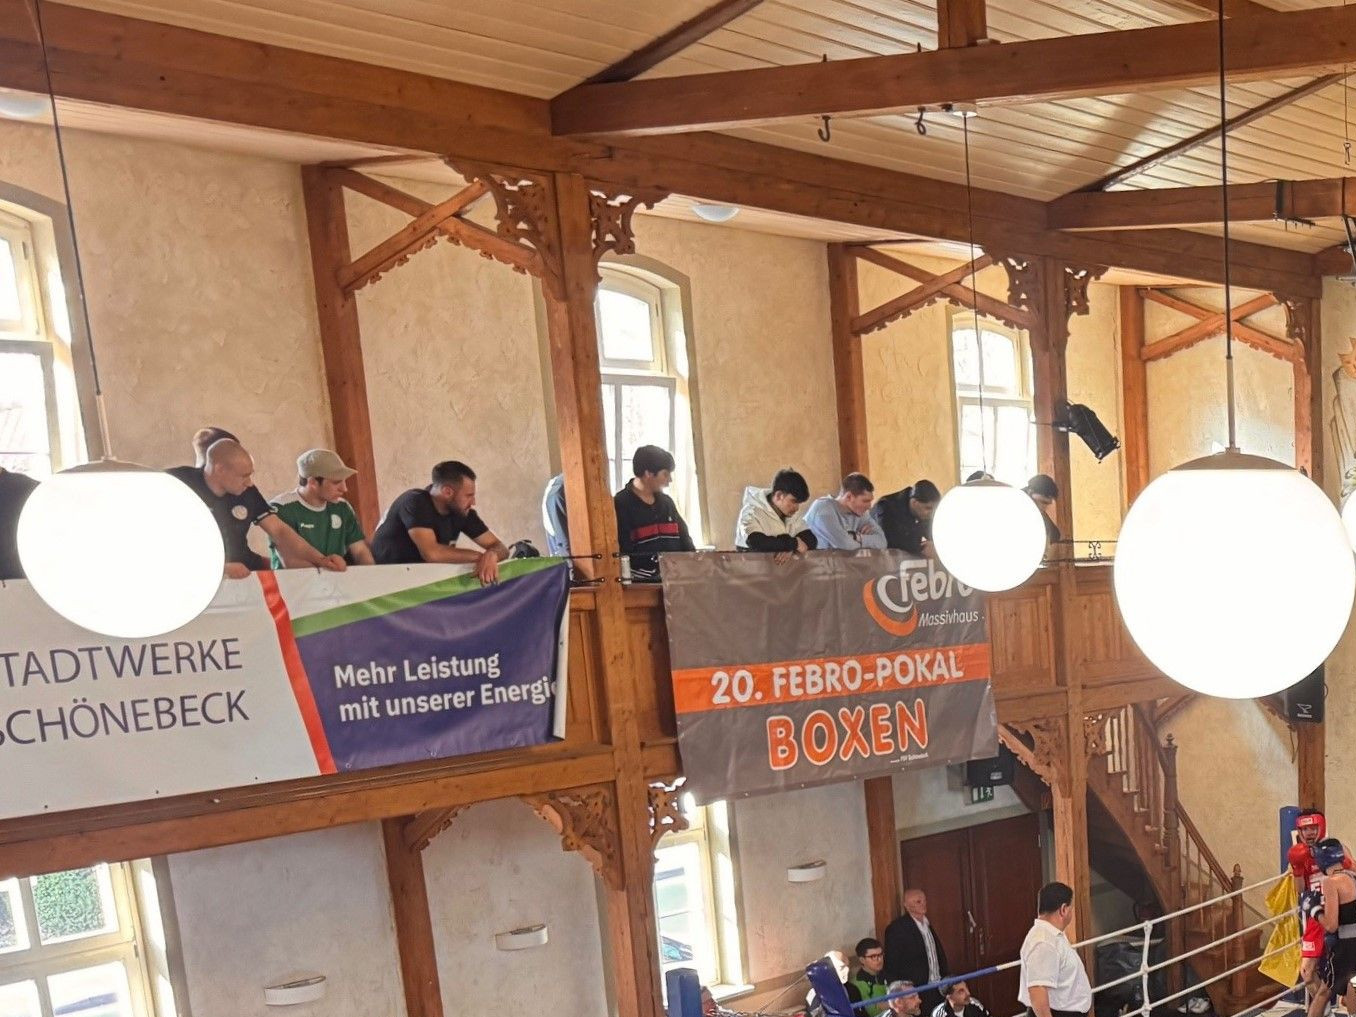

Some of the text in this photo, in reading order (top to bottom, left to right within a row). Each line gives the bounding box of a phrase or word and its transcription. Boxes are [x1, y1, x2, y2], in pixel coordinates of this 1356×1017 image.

[918, 609, 979, 627] Massivhaus
[0, 638, 243, 687] TADTWERKE
[334, 653, 500, 688] Mehr Leistung
[711, 651, 964, 704] 20. FEBRO-POKAL
[339, 695, 380, 722] mit
[386, 689, 475, 716] unserer
[766, 698, 929, 771] BOXEN
